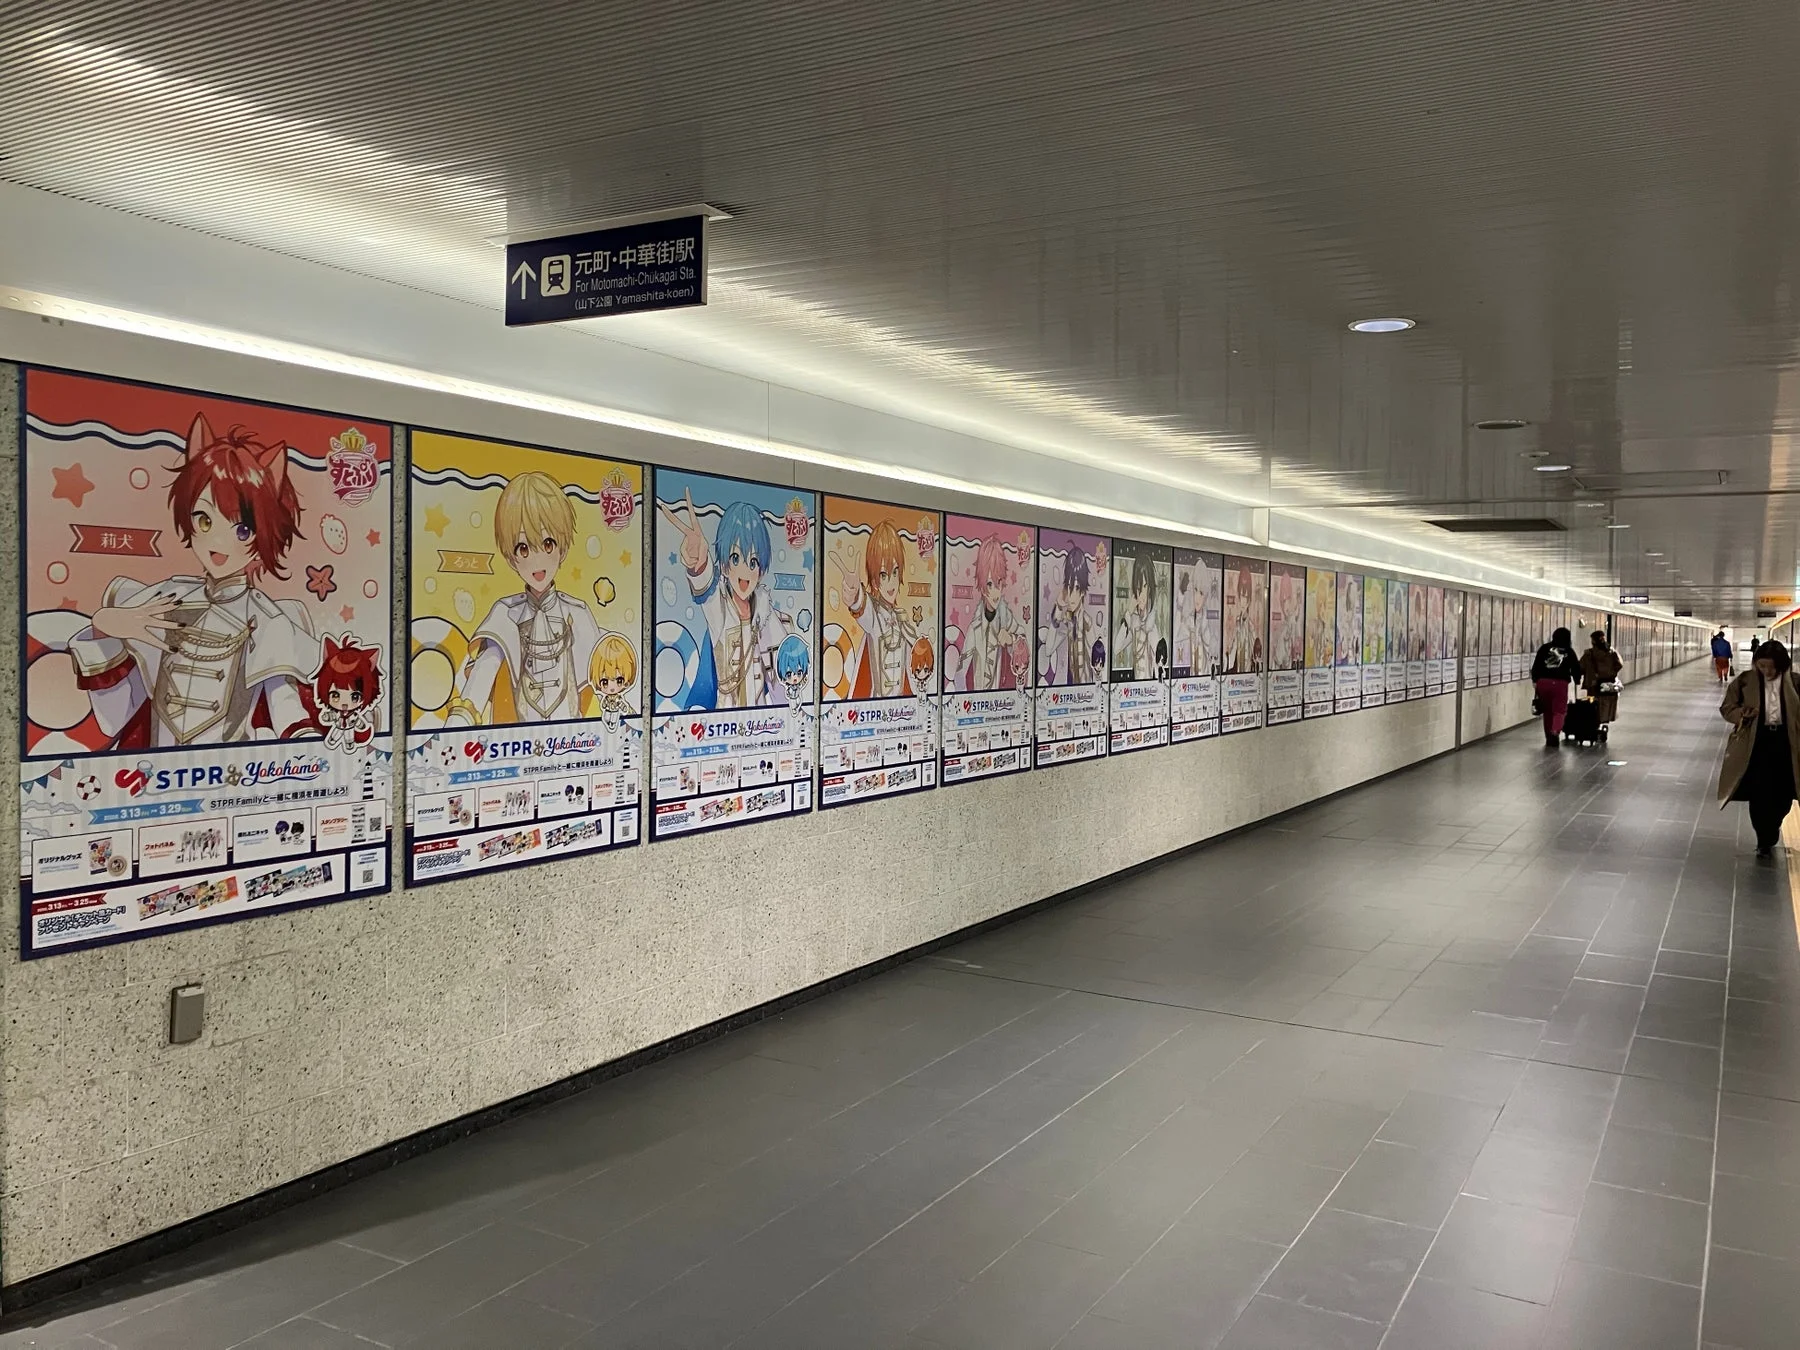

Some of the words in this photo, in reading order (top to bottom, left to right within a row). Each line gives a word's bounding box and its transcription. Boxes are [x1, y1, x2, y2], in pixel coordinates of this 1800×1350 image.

[575, 237, 695, 276] 元町・中華街駅
[575, 280, 589, 293] For
[679, 266, 697, 280] Sta.
[574, 295, 613, 311] (山下公園
[328, 454, 378, 488] すとぷり
[100, 532, 134, 550] 莉犬
[860, 710, 882, 722] STPR
[708, 723, 738, 737] STPR
[490, 740, 533, 758] STPR
[543, 735, 596, 757] Yokohama
[156, 766, 223, 790] STPR
[241, 758, 323, 787] Yokohama
[211, 799, 234, 809] STPR
